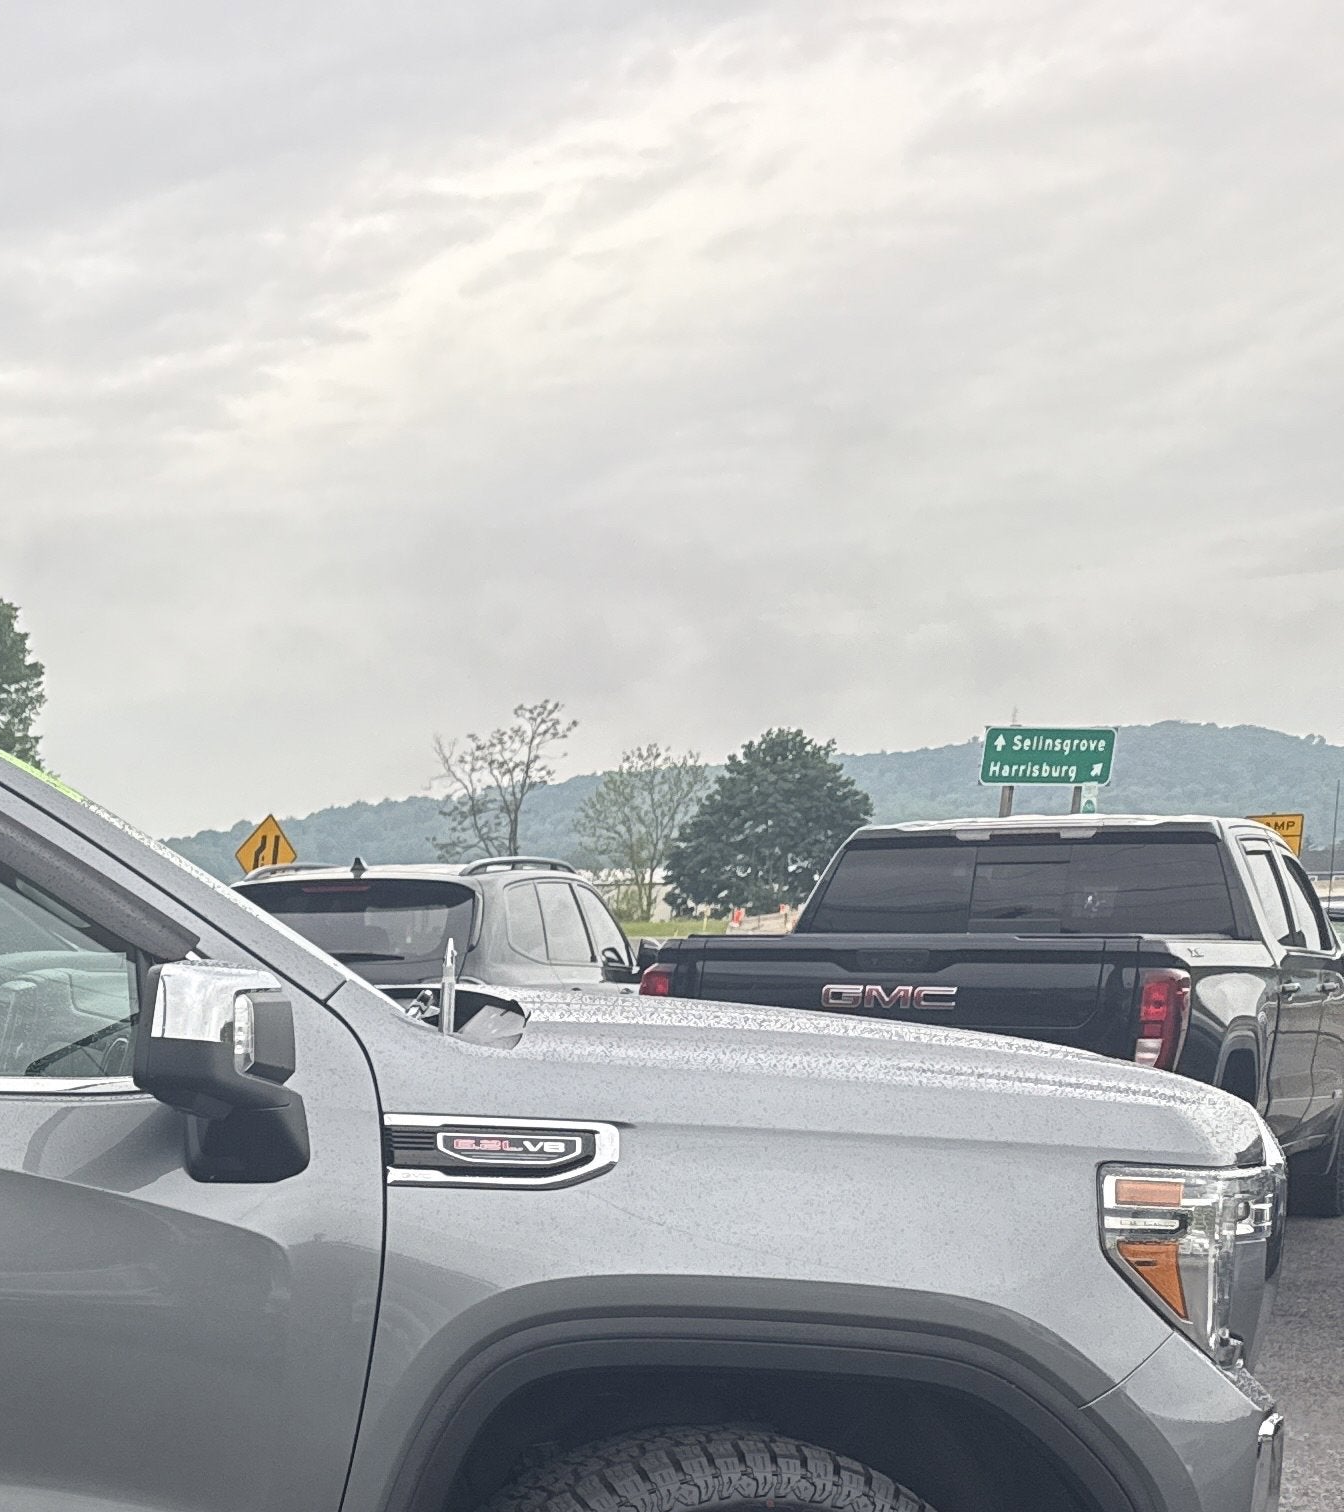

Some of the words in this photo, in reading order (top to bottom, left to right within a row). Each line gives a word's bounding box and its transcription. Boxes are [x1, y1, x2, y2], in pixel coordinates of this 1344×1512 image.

[1012, 735, 1106, 755] Selinsgrove
[989, 761, 1077, 782] Harrisburg
[821, 984, 958, 1010] GMC
